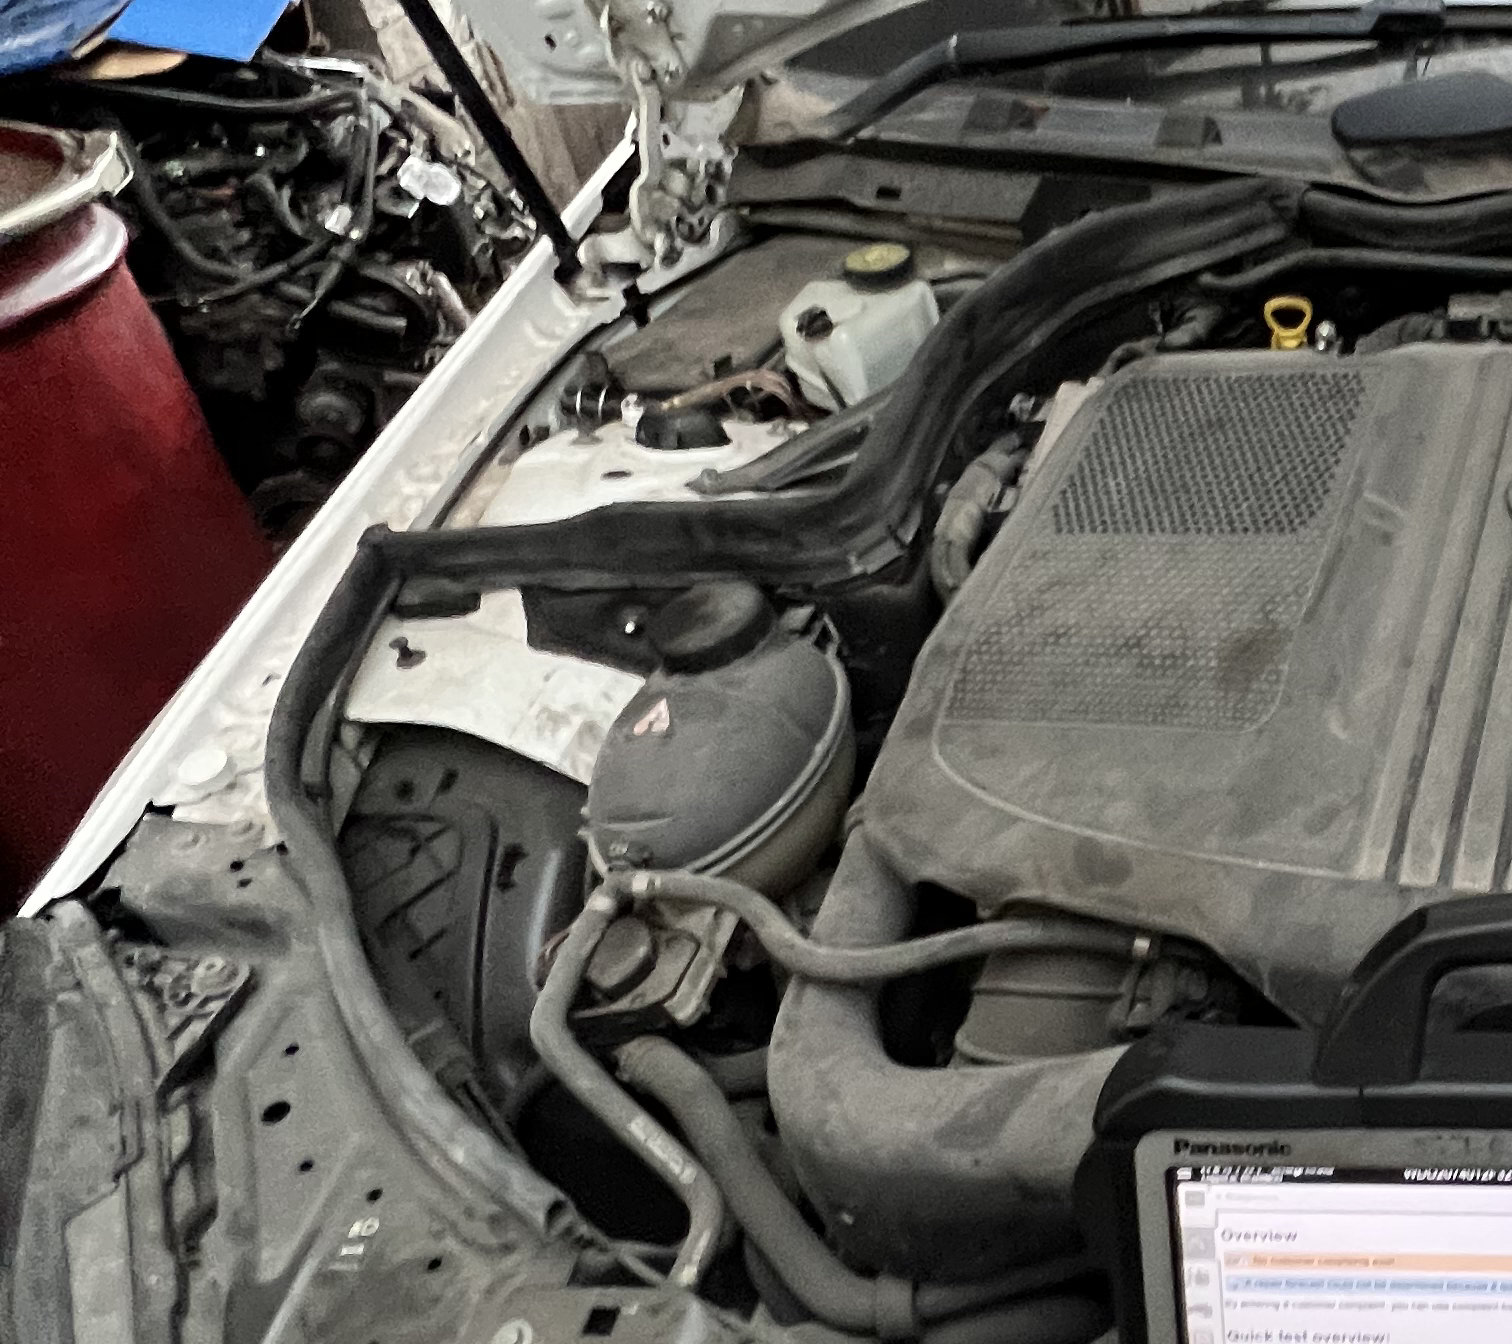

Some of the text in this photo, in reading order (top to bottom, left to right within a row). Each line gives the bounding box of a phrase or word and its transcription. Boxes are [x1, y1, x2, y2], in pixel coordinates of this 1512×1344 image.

[1173, 1138, 1292, 1157] Panasonic
[1221, 1228, 1298, 1243] Overview
[1227, 1329, 1273, 1344] Quick
[1278, 1329, 1308, 1343] test
